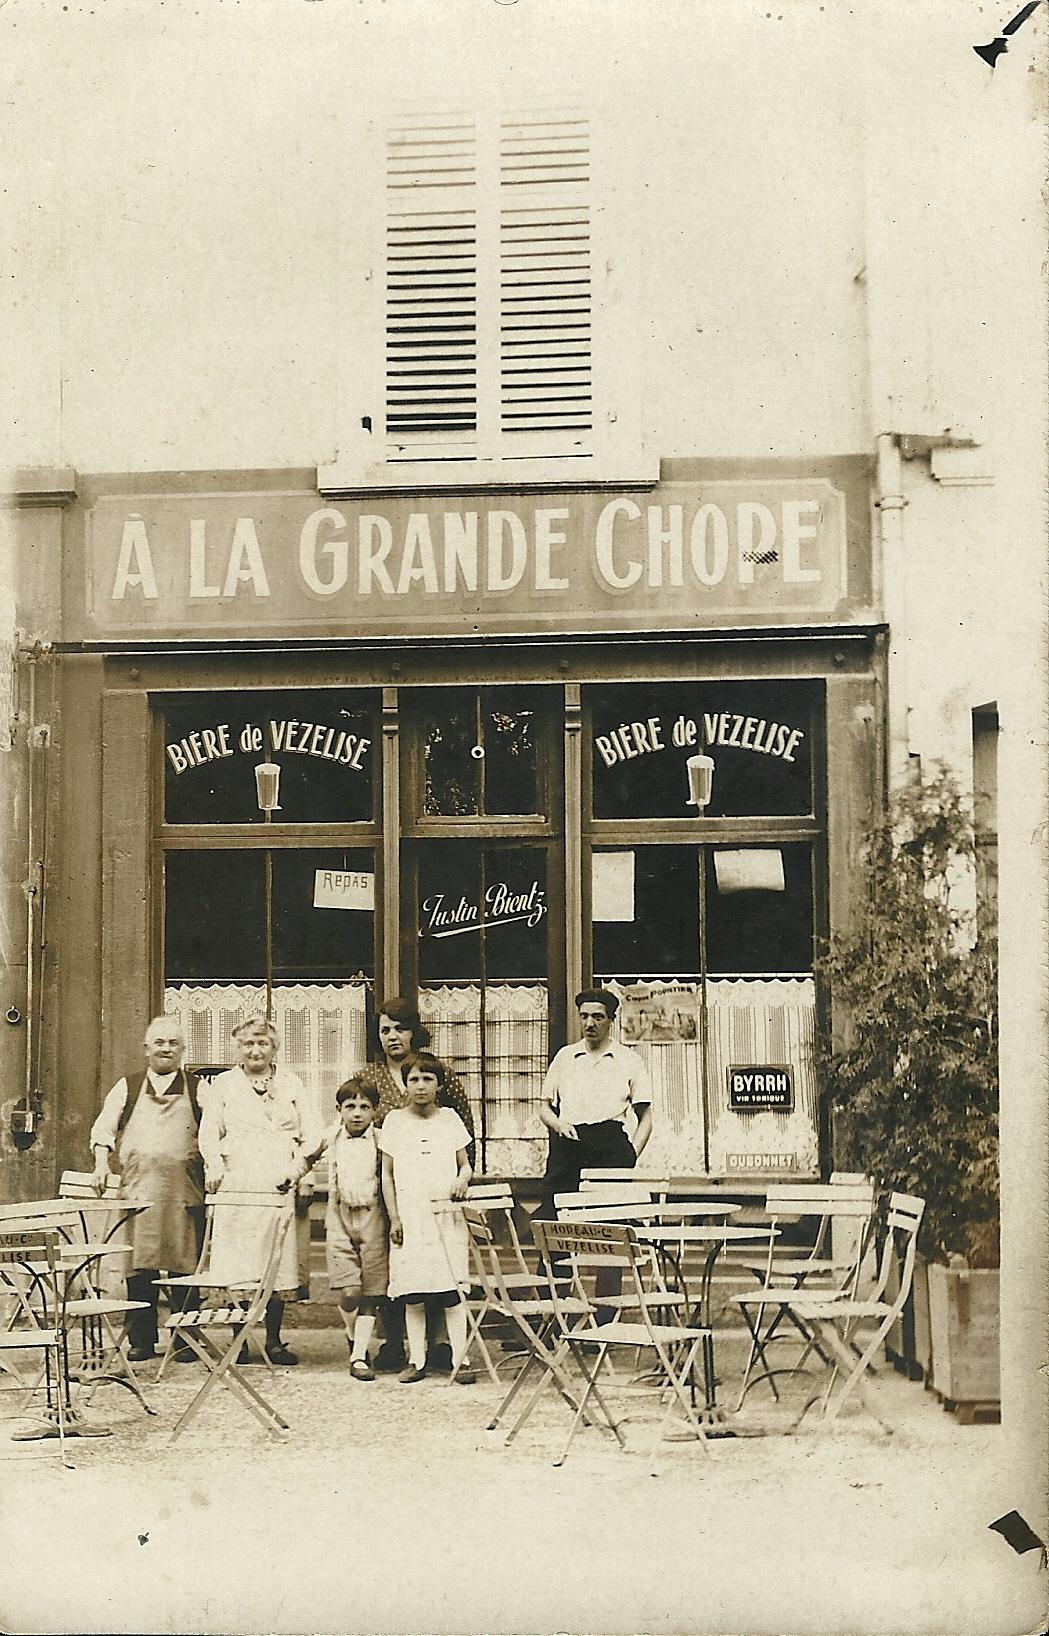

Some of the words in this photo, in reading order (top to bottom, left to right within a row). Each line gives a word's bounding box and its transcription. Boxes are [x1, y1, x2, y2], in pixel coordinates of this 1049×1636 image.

[189, 517, 272, 599] LA
[298, 507, 570, 596] GRANDE
[595, 497, 822, 590] CHOPE
[166, 724, 234, 775] BIÈRE
[239, 723, 264, 753] de
[595, 717, 666, 768] BIÈRE
[671, 715, 698, 748] de
[484, 881, 548, 928] Bientz
[733, 1074, 787, 1092] BYRRH
[729, 1154, 793, 1168] DUBONNET
